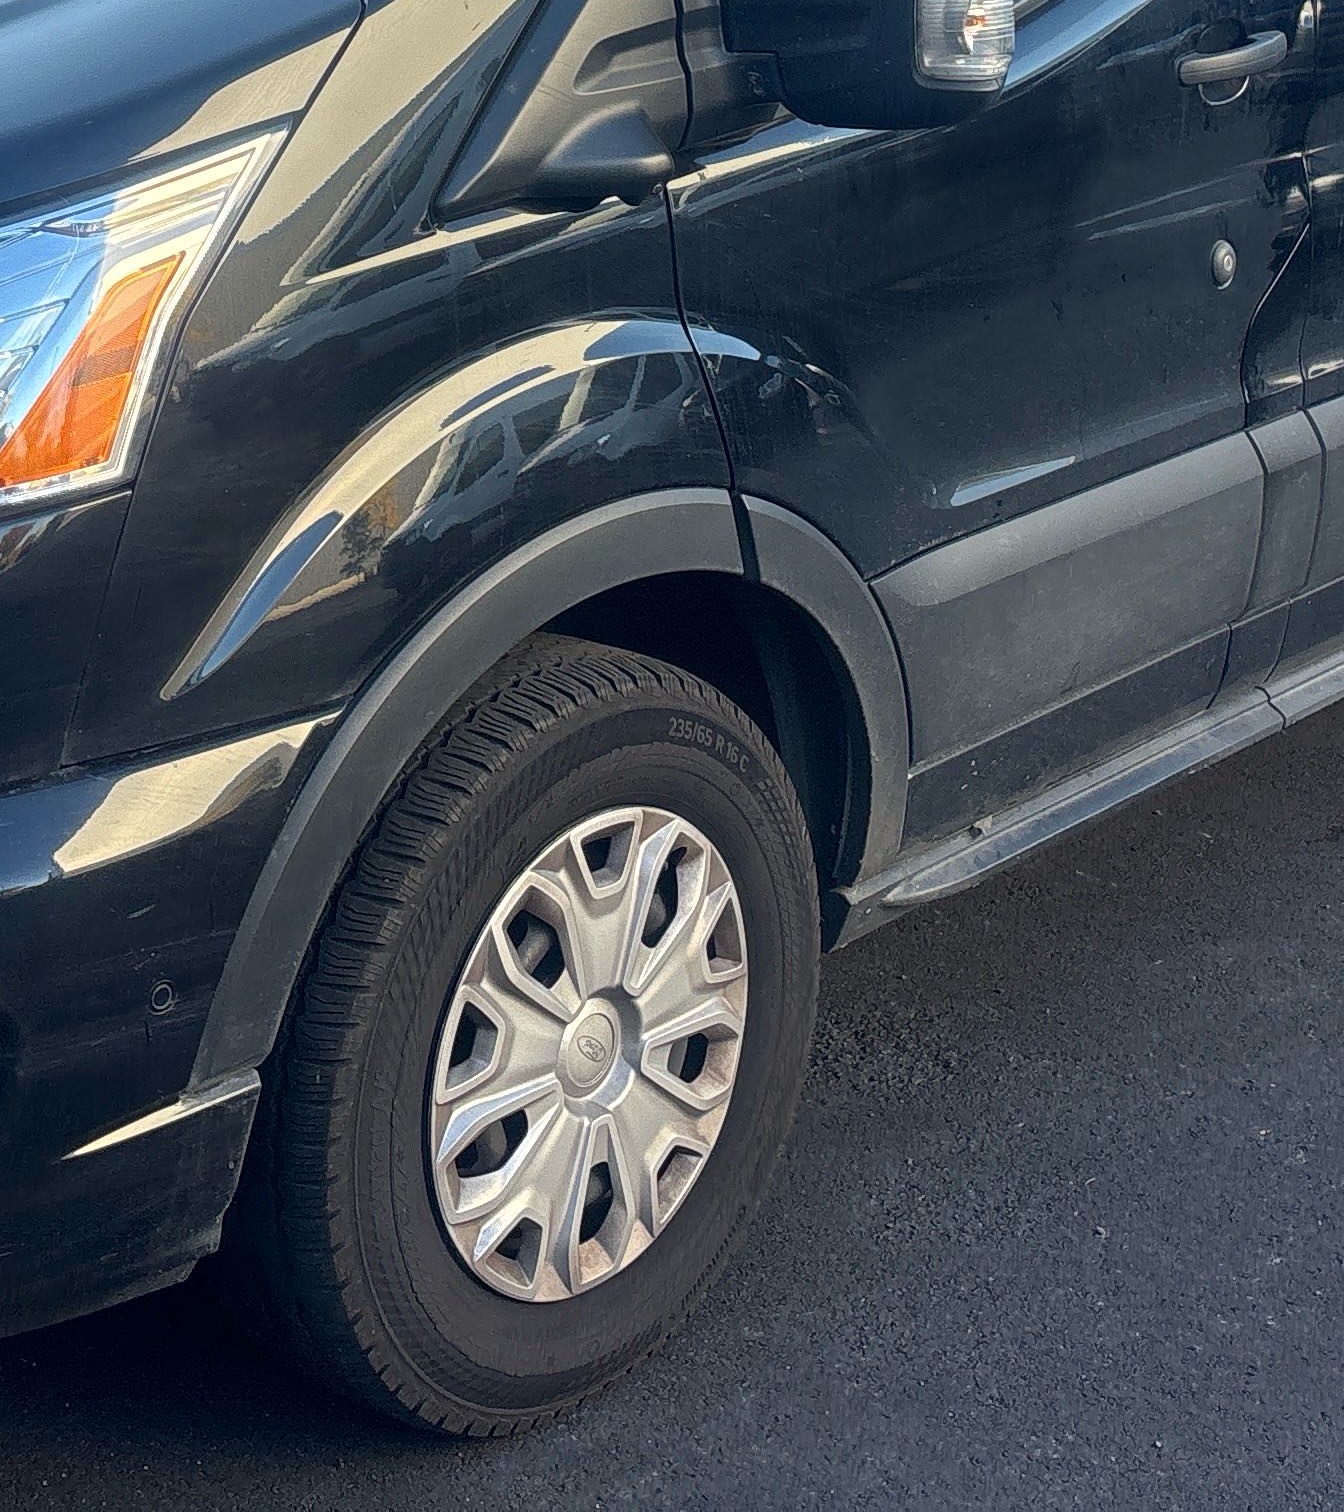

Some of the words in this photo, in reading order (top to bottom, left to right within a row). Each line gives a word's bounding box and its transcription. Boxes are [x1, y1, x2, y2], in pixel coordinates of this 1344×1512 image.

[668, 716, 713, 746] 235/65
[715, 734, 725, 755] R
[726, 741, 739, 764] 16
[740, 755, 749, 773] C
